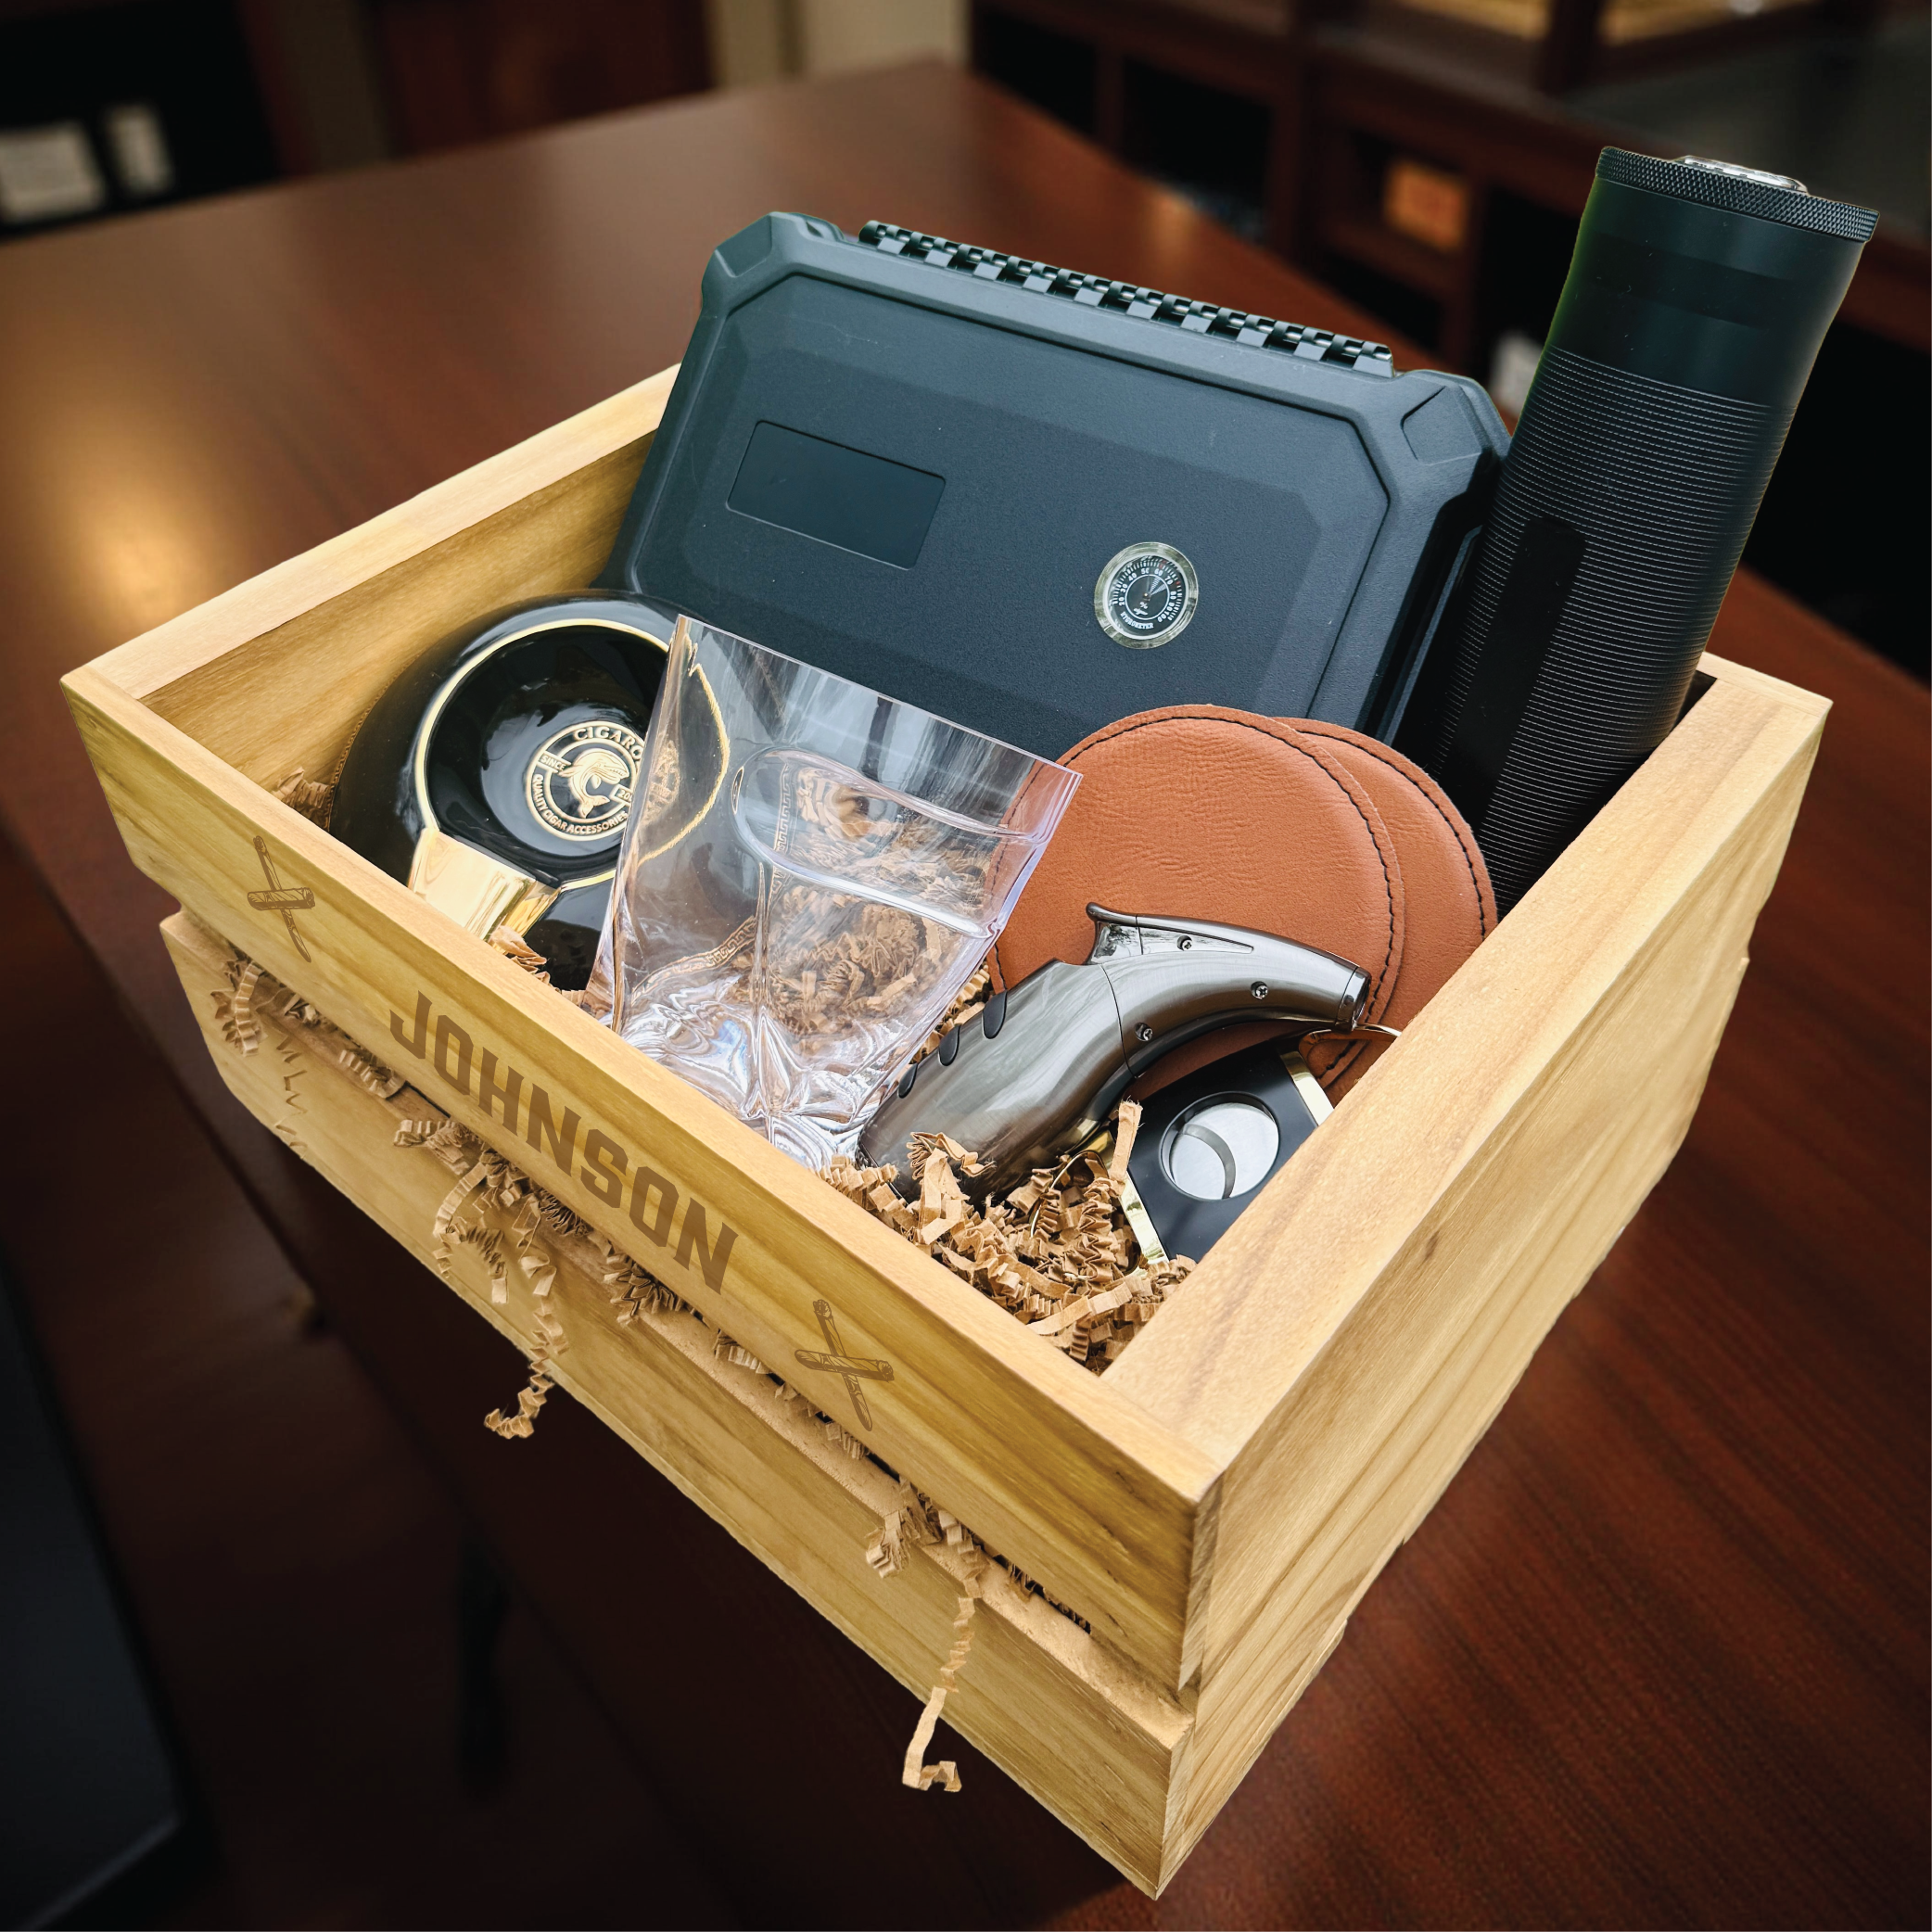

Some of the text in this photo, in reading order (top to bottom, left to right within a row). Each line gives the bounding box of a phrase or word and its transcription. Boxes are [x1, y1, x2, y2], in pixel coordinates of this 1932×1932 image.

[1128, 572, 1138, 581] 40
[1164, 577, 1173, 585] 70
[1120, 583, 1128, 593] 30
[1120, 611, 1154, 629] HYGROMETER
[573, 726, 644, 769] CIGARO
[540, 752, 567, 772] SINCE
[532, 773, 629, 835] QUALITY CIGAR ACCESSORIES
[389, 990, 740, 1295] JOHNSON
